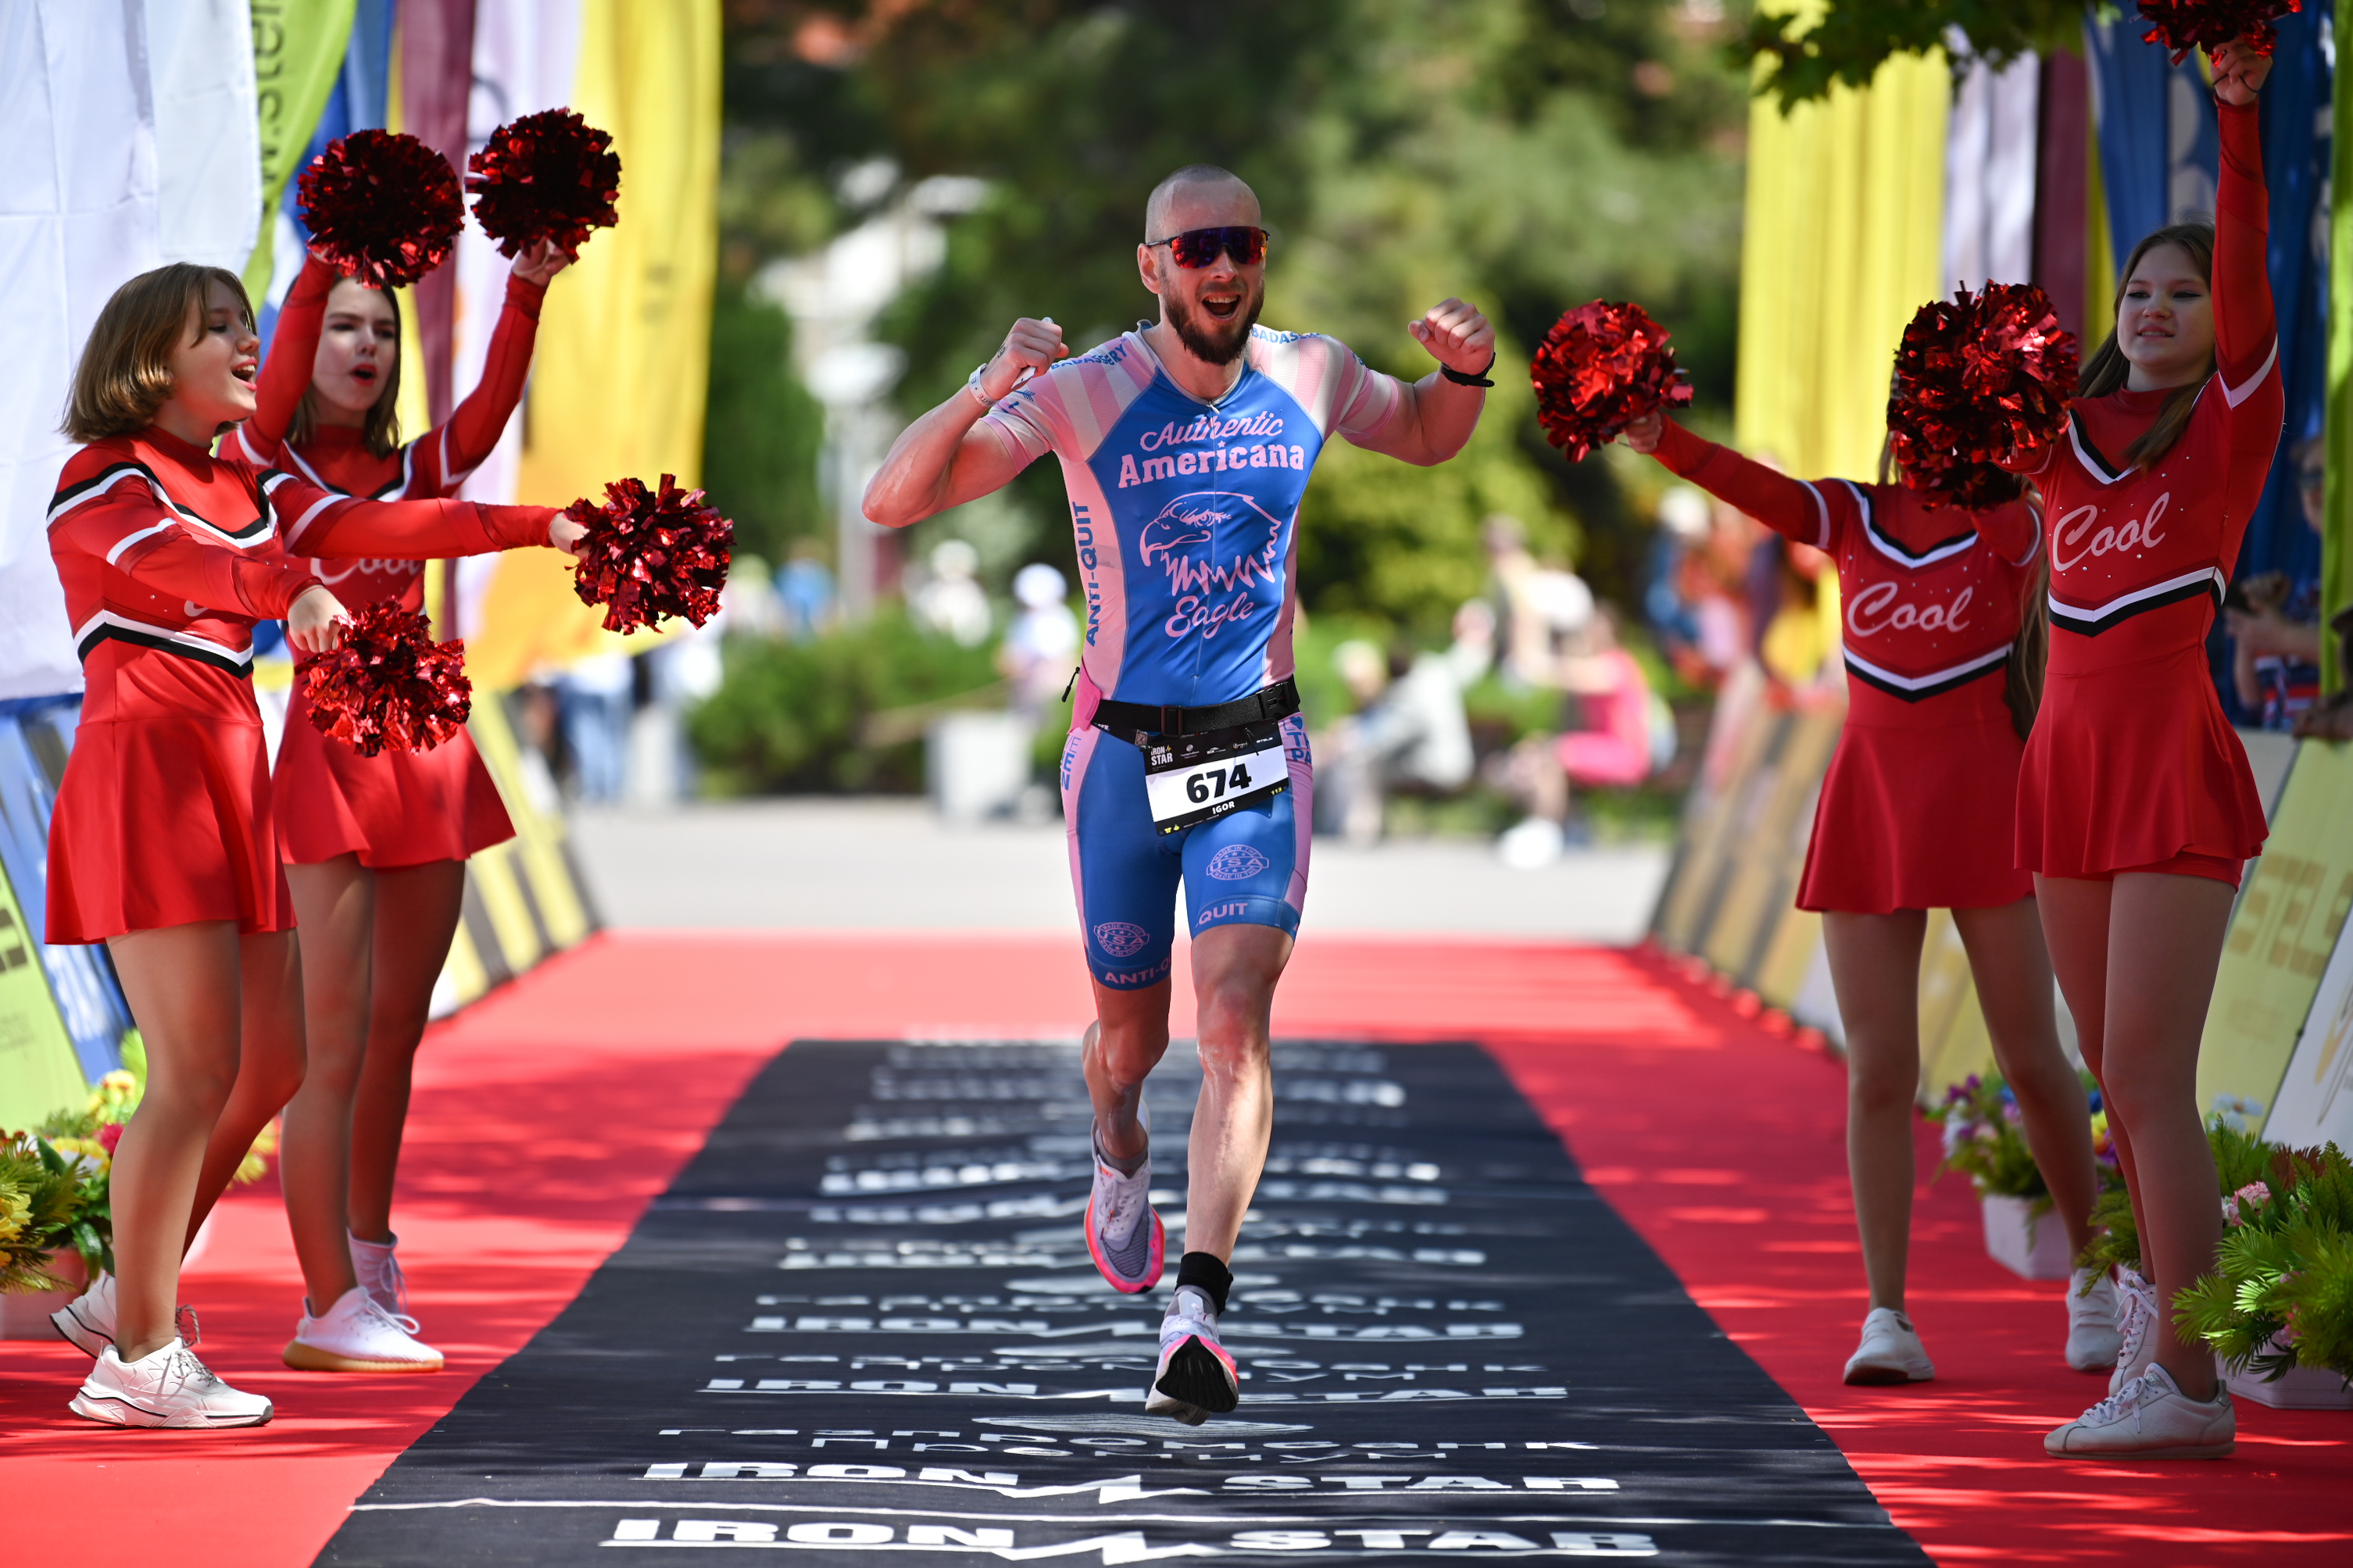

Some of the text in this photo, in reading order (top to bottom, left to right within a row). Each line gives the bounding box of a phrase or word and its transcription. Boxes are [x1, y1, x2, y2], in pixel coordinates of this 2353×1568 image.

[1139, 411, 1283, 452] Authentic
[1118, 441, 1304, 488] Americana
[2053, 491, 2170, 571] Cool
[1072, 502, 1100, 647] ANTI-QUIT
[1164, 591, 1254, 639] Eagle
[1847, 581, 1974, 637] Cool
[1150, 745, 1165, 755] IRON
[1151, 752, 1173, 766] STAR
[1186, 763, 1252, 804] 674
[1212, 801, 1236, 815] IGOR
[1210, 858, 1264, 872] USA
[1214, 847, 1232, 861] MADE
[1245, 847, 1258, 855] THE
[1096, 927, 1144, 945] USA
[1104, 956, 1171, 984] ANTI-Q
[752, 1316, 1049, 1332] IRON
[707, 1378, 1569, 1401] IRON STAR
[810, 1438, 1446, 1463] Премиум
[644, 1462, 1620, 1490] IRON STAR
[613, 1519, 1655, 1551] IRON STAR
